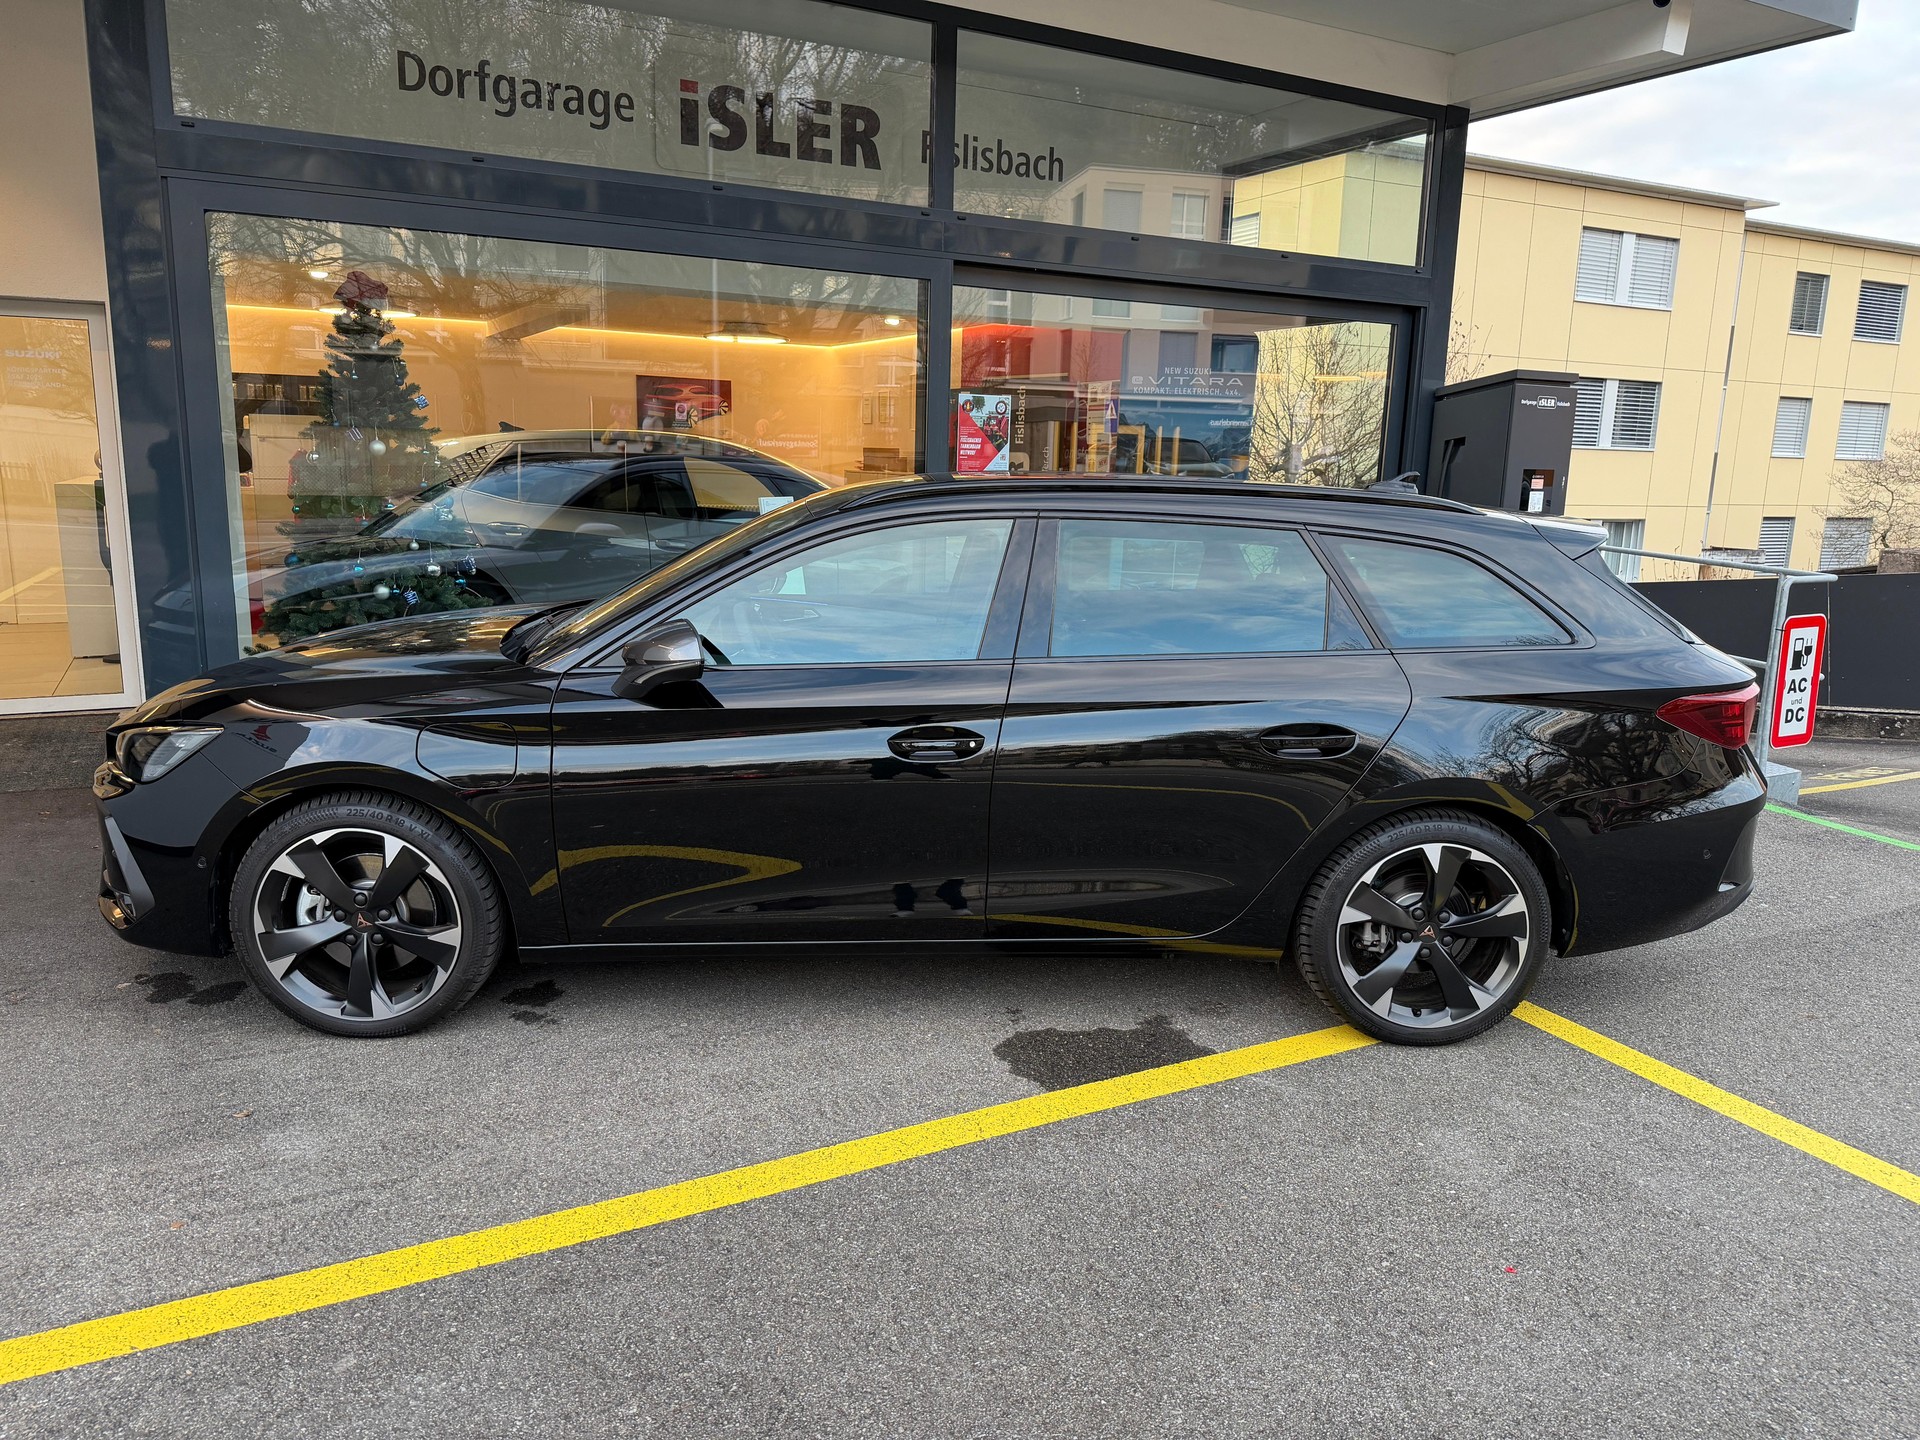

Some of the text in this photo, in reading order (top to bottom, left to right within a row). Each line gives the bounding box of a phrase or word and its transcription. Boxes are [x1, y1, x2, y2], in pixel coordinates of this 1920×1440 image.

[397, 50, 635, 130] Dorfgarage
[921, 130, 1064, 182] Fslisbach
[5, 349, 61, 359] SUZUKI
[1164, 366, 1212, 375] NEW SUZUKI
[1148, 376, 1244, 386] VITARA
[1174, 387, 1222, 396] ELEKTRISCH.
[1224, 388, 1241, 396] 4x4.
[1014, 385, 1026, 444] Fislisbach
[1787, 677, 1807, 694] AC
[1791, 697, 1803, 705] und
[1785, 707, 1805, 723] DC
[346, 808, 383, 820] 225/40
[385, 814, 393, 823] R
[394, 817, 406, 828] 18
[409, 824, 417, 832] V
[1387, 826, 1421, 842] 225/40
[1424, 825, 1431, 833] R
[1432, 824, 1443, 832] 18
